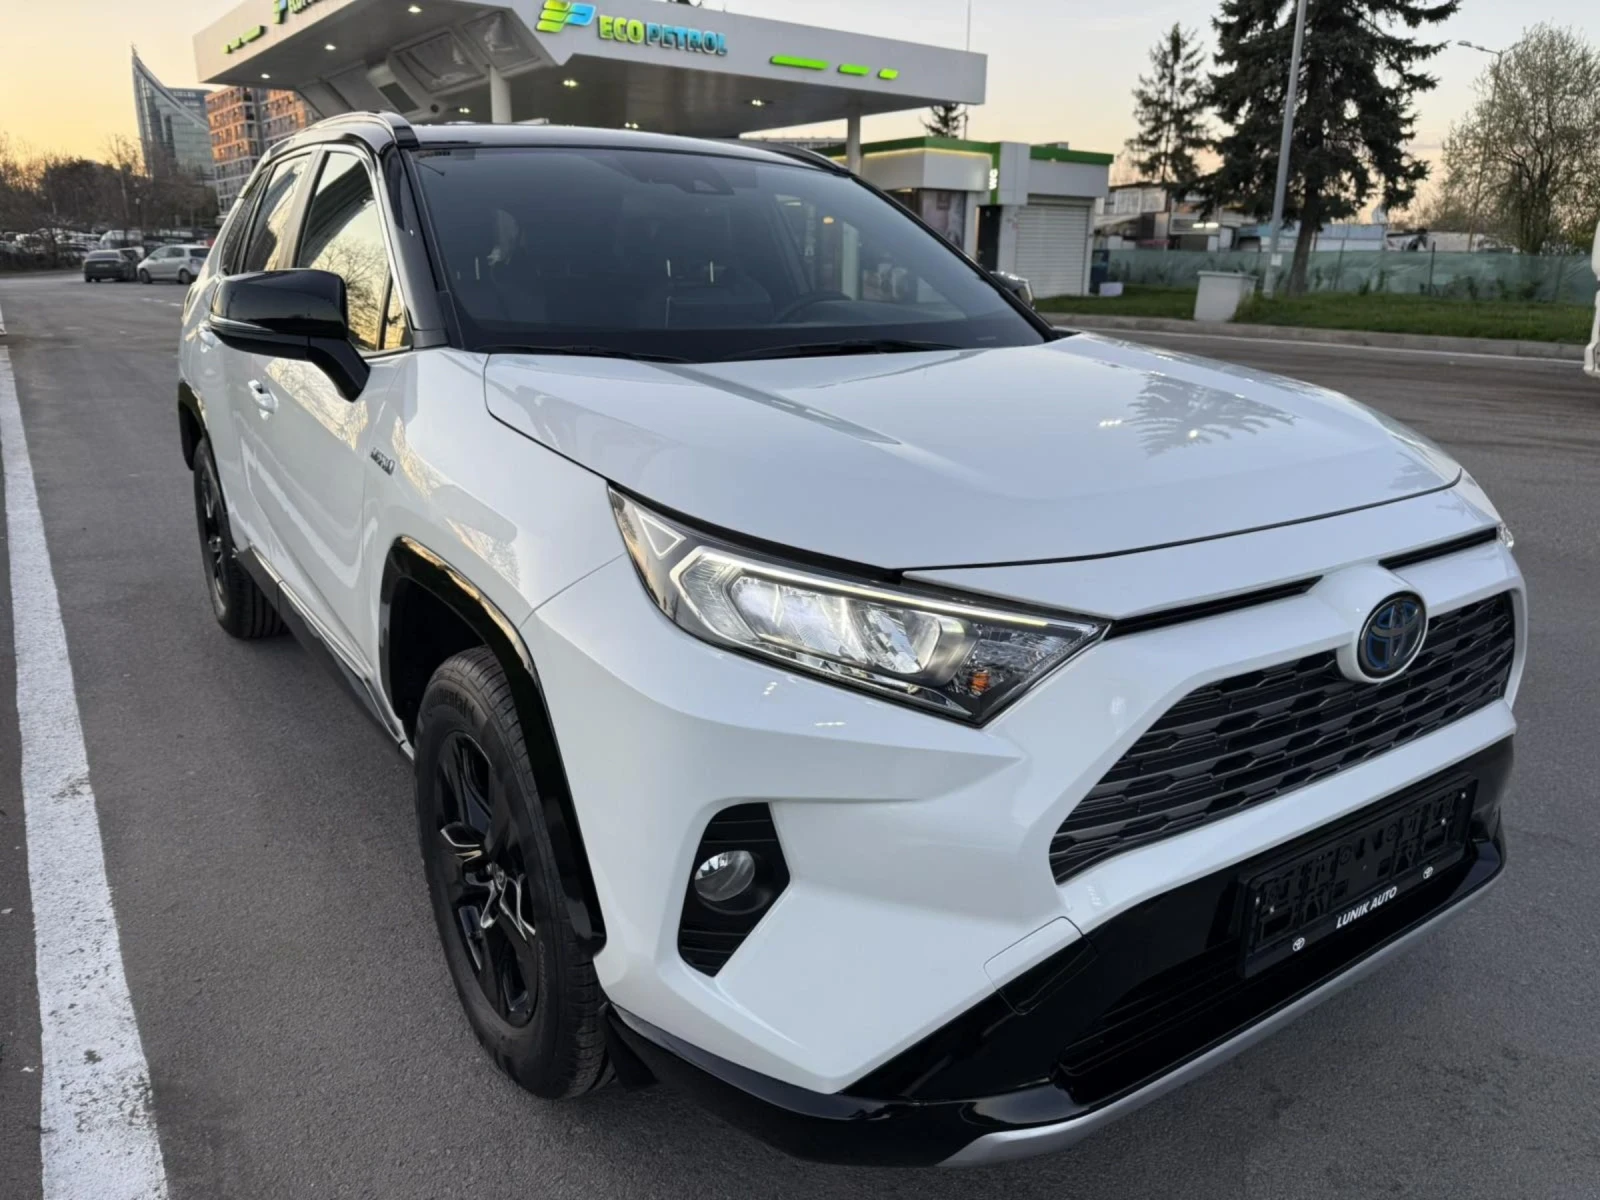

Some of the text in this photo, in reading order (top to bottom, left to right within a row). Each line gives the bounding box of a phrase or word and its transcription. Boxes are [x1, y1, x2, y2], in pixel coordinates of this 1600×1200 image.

[598, 14, 727, 55] ECOPETROL
[1336, 886, 1397, 929] LUNIK AUTO
